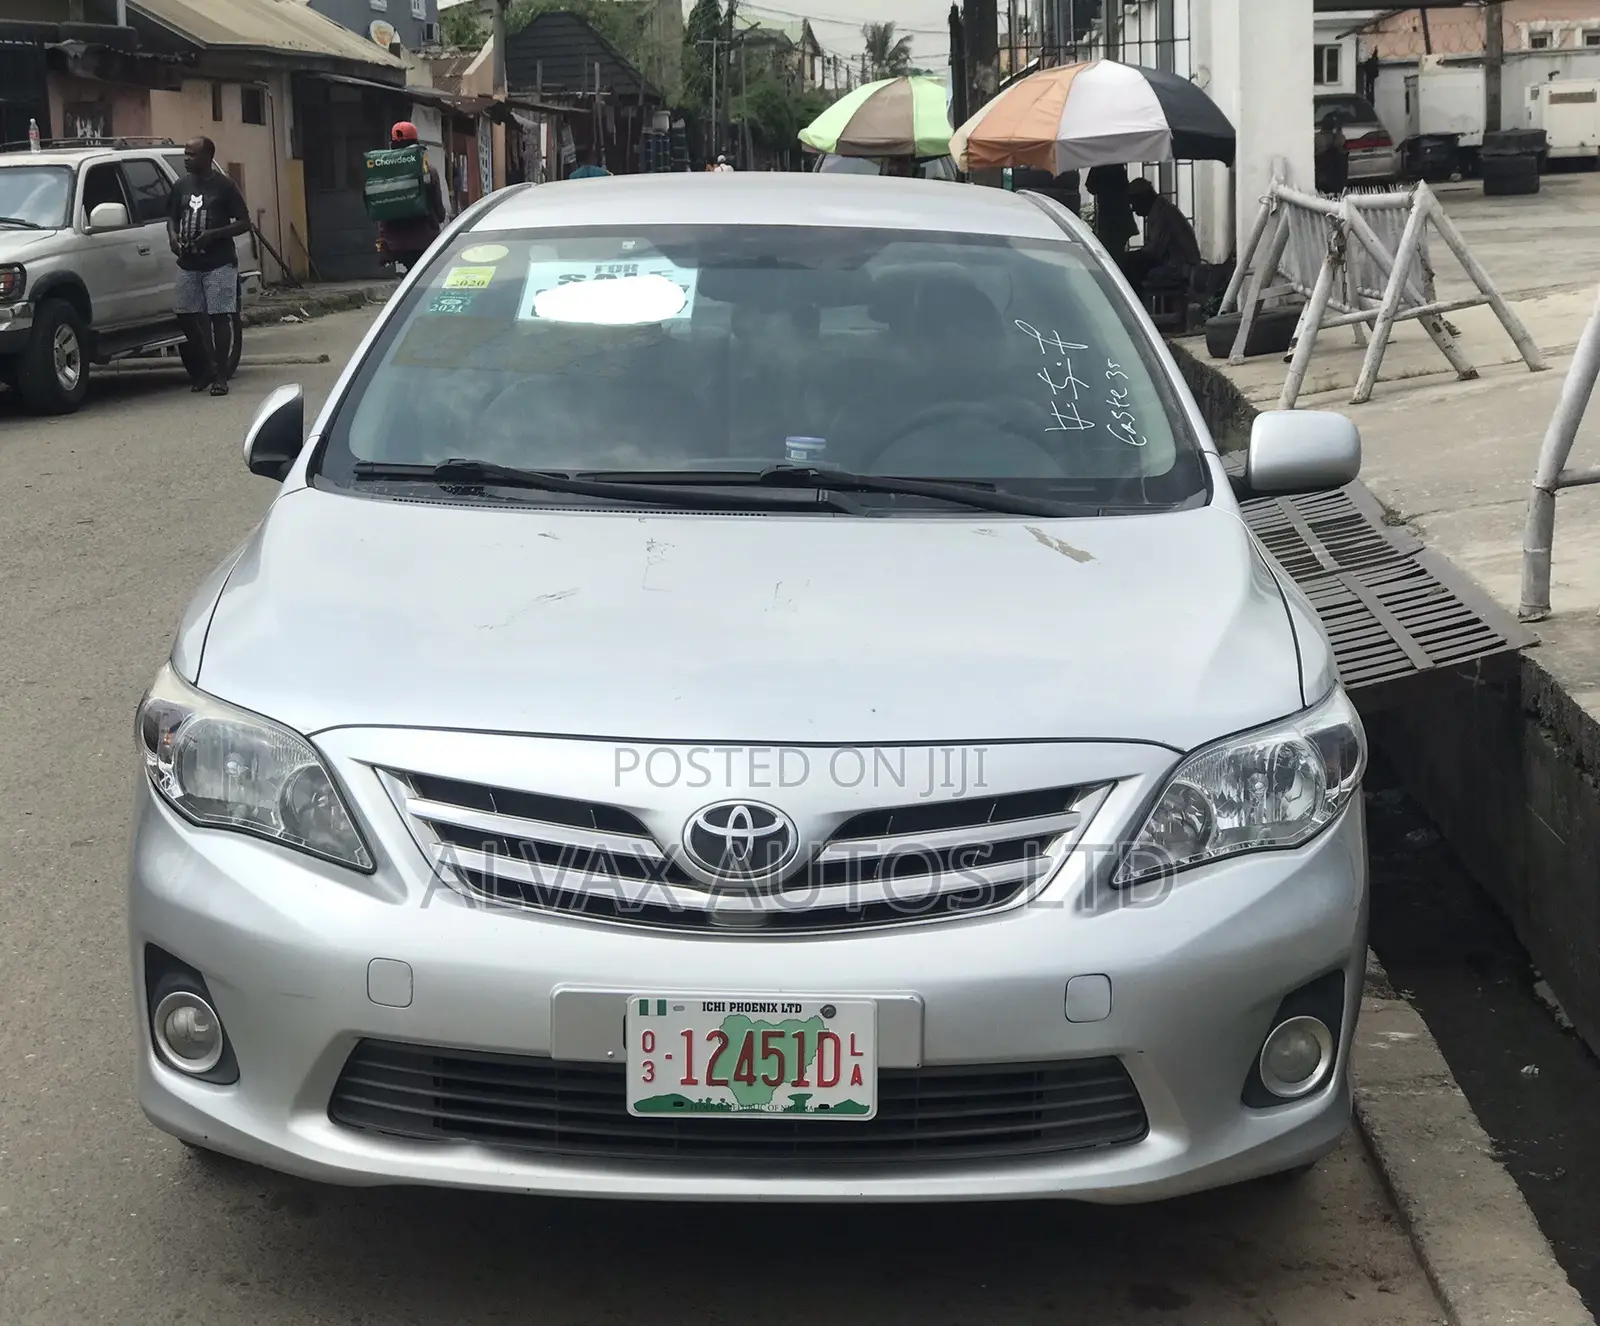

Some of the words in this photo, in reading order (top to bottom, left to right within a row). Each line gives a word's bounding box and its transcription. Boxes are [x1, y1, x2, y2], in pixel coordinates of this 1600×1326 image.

[375, 154, 416, 167] Chowdeck
[451, 279, 486, 287] 2020
[429, 303, 464, 313] 2021
[702, 1001, 726, 1013] ICHI
[729, 1002, 778, 1013] PHOENIX
[781, 1003, 802, 1014] LTD
